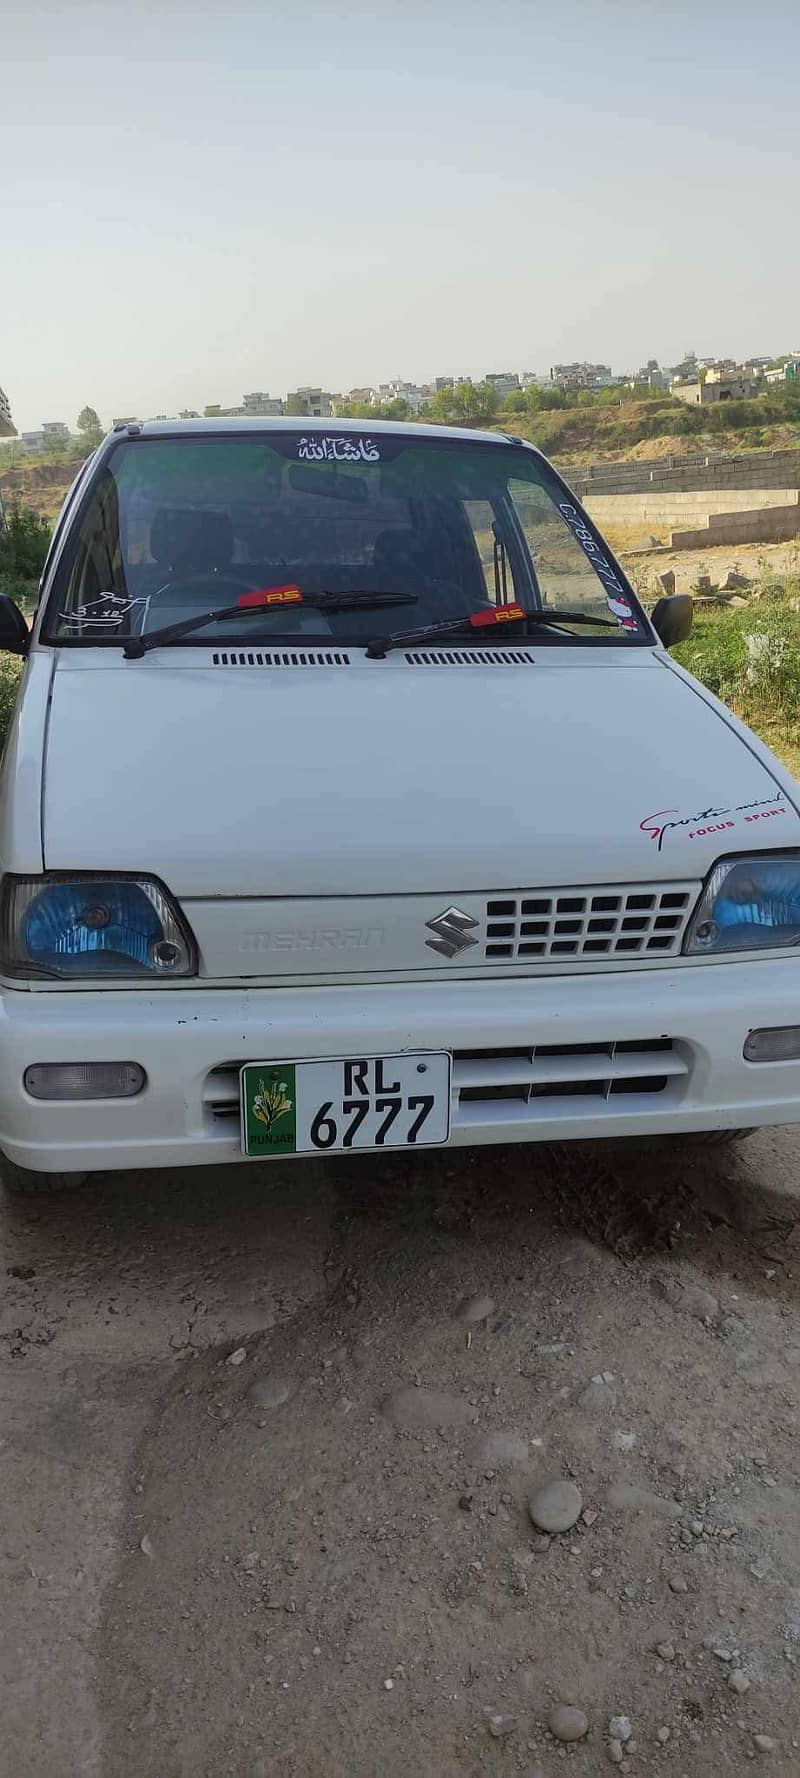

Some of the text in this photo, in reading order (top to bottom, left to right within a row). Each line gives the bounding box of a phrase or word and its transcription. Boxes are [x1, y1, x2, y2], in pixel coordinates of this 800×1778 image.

[266, 590, 301, 603] RS
[495, 608, 525, 621] RS
[735, 791, 785, 811] mind
[688, 806, 788, 839] FOCUS SPORT
[240, 927, 387, 952] MEHRAN
[343, 1059, 401, 1096] RL
[310, 1095, 435, 1149] 6777
[249, 1134, 294, 1145] PUNJAB
